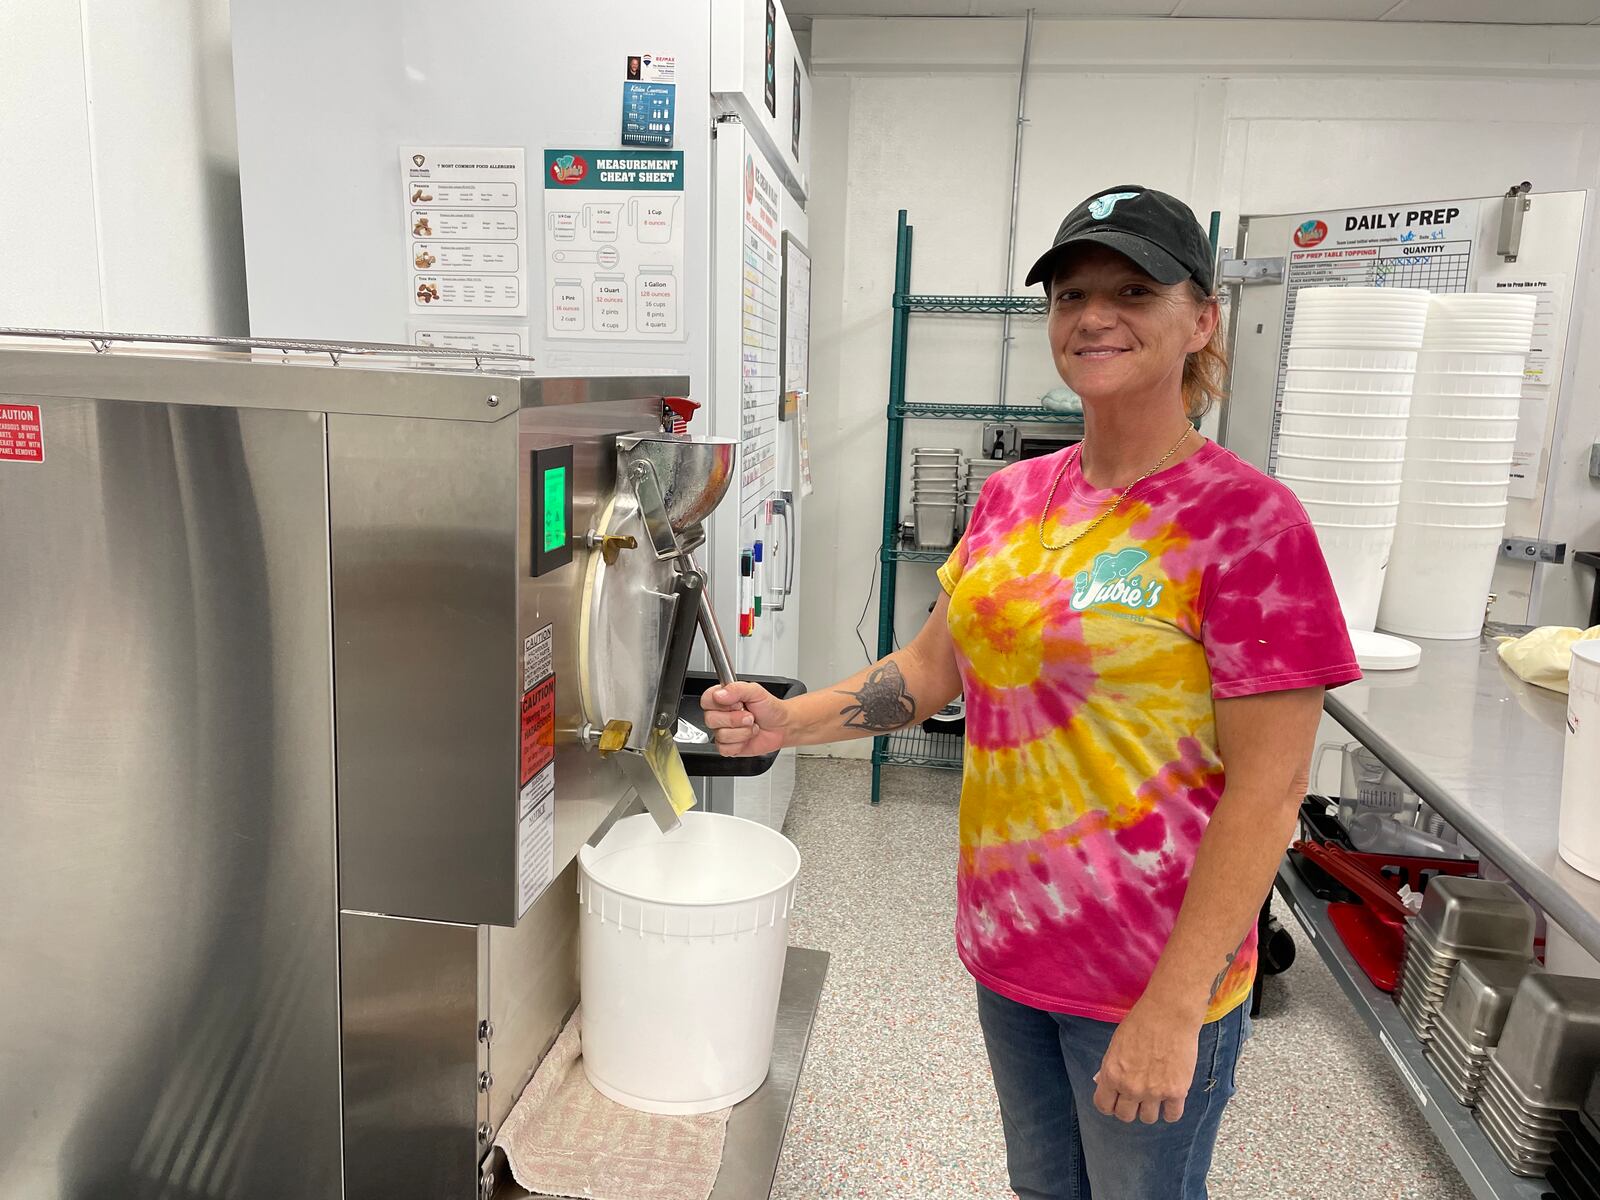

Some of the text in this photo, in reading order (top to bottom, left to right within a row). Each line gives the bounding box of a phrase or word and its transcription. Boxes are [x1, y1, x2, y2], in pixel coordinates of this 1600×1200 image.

[597, 159, 678, 170] MEASUREMENT
[600, 172, 674, 182] CHEAT SHEET
[1345, 208, 1460, 232] DAILY PREP
[1403, 245, 1445, 255] QUANTITY
[1070, 557, 1164, 610] Jubie's
[526, 628, 551, 649] CAUTION
[522, 681, 554, 713] CAUTION
